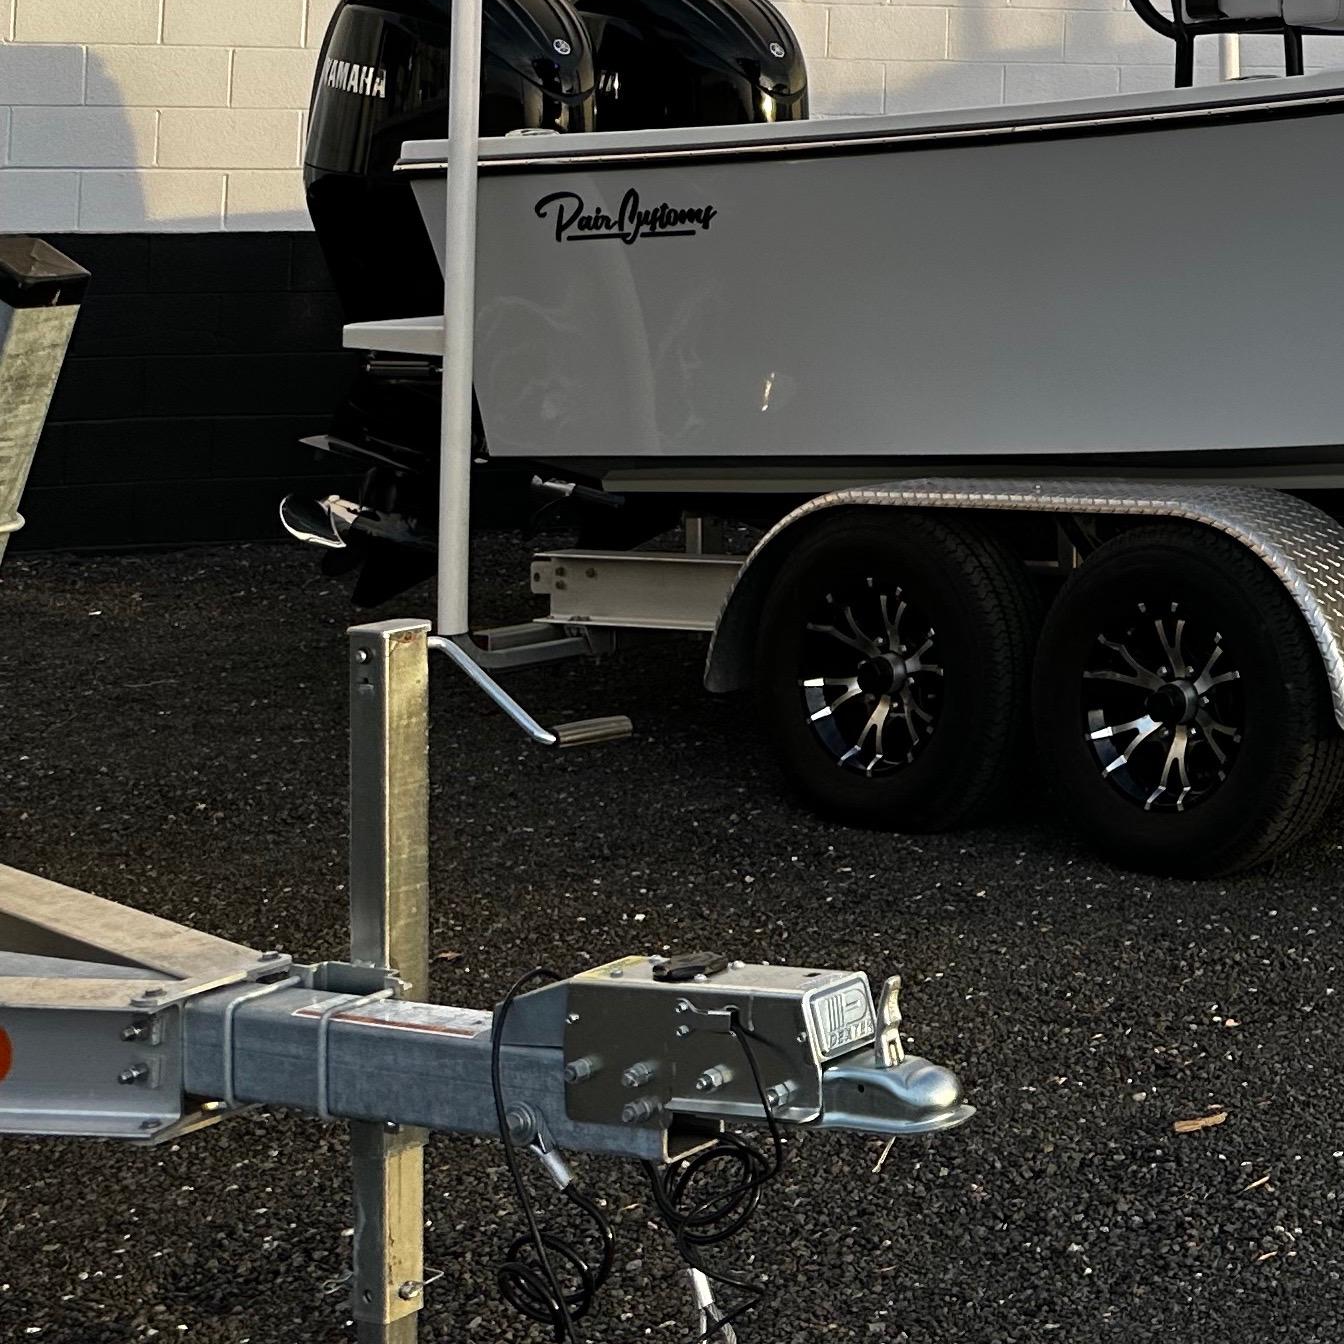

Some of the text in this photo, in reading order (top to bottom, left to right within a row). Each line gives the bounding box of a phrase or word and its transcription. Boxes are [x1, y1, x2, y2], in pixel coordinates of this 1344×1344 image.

[324, 58, 387, 98] YAMAHA
[534, 187, 718, 245] Pair Customs
